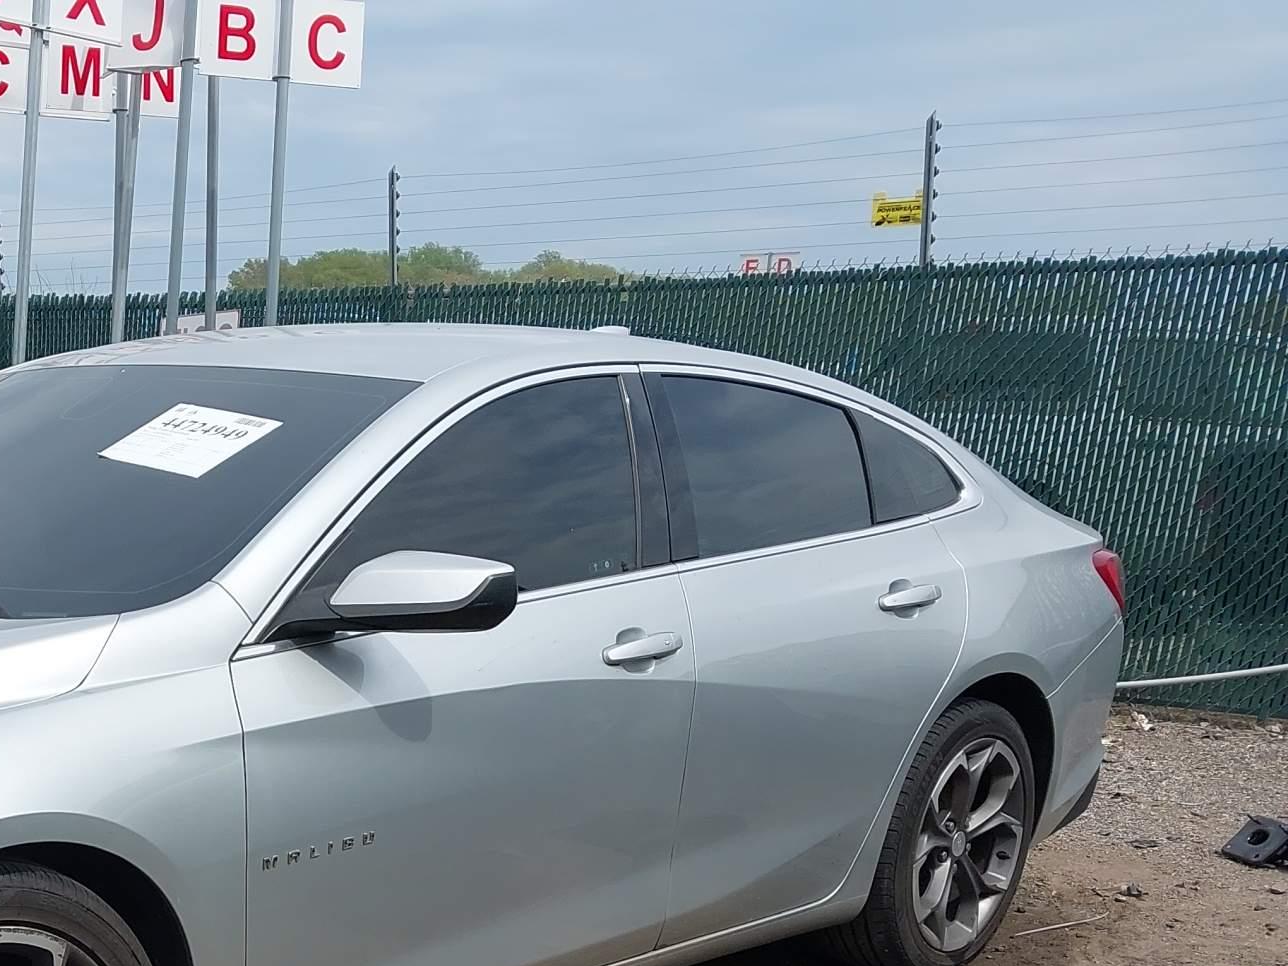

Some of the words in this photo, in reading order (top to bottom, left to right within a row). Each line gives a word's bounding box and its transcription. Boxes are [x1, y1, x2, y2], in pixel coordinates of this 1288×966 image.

[132, 0, 164, 50] J
[218, 4, 256, 61] B
[308, 14, 346, 70] C
[61, 45, 101, 97] M
[142, 67, 175, 102] N
[162, 418, 249, 440] 44724949
